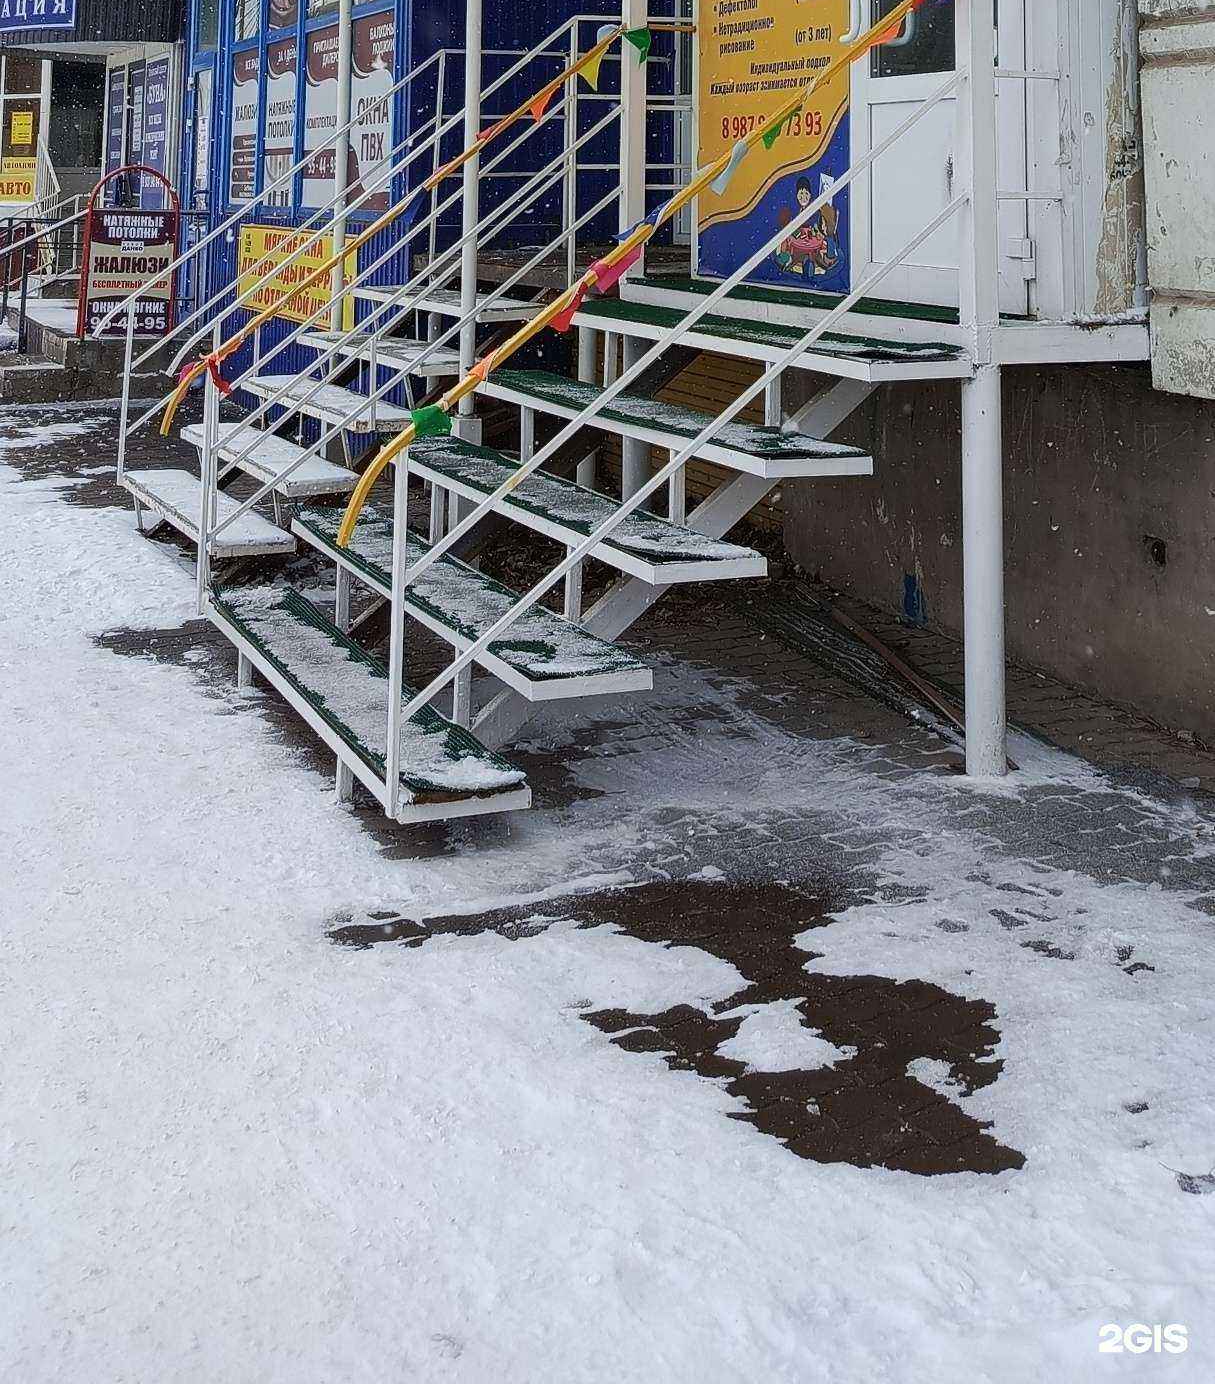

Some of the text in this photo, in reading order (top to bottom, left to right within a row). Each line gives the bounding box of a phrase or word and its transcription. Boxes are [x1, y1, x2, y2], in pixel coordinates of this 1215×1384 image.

[795, 28, 807, 47] (от
[809, 25, 814, 41] 3
[815, 24, 832, 43] лет)
[357, 97, 389, 125] ОКНА
[722, 117, 729, 138] 8
[805, 111, 822, 136] 93
[361, 132, 383, 162] ПВХ
[103, 215, 164, 227] НАТЯЖНЫЕ
[108, 226, 159, 239] ПОТОЛКИ
[93, 256, 169, 274] ЖАЛЮЗИ
